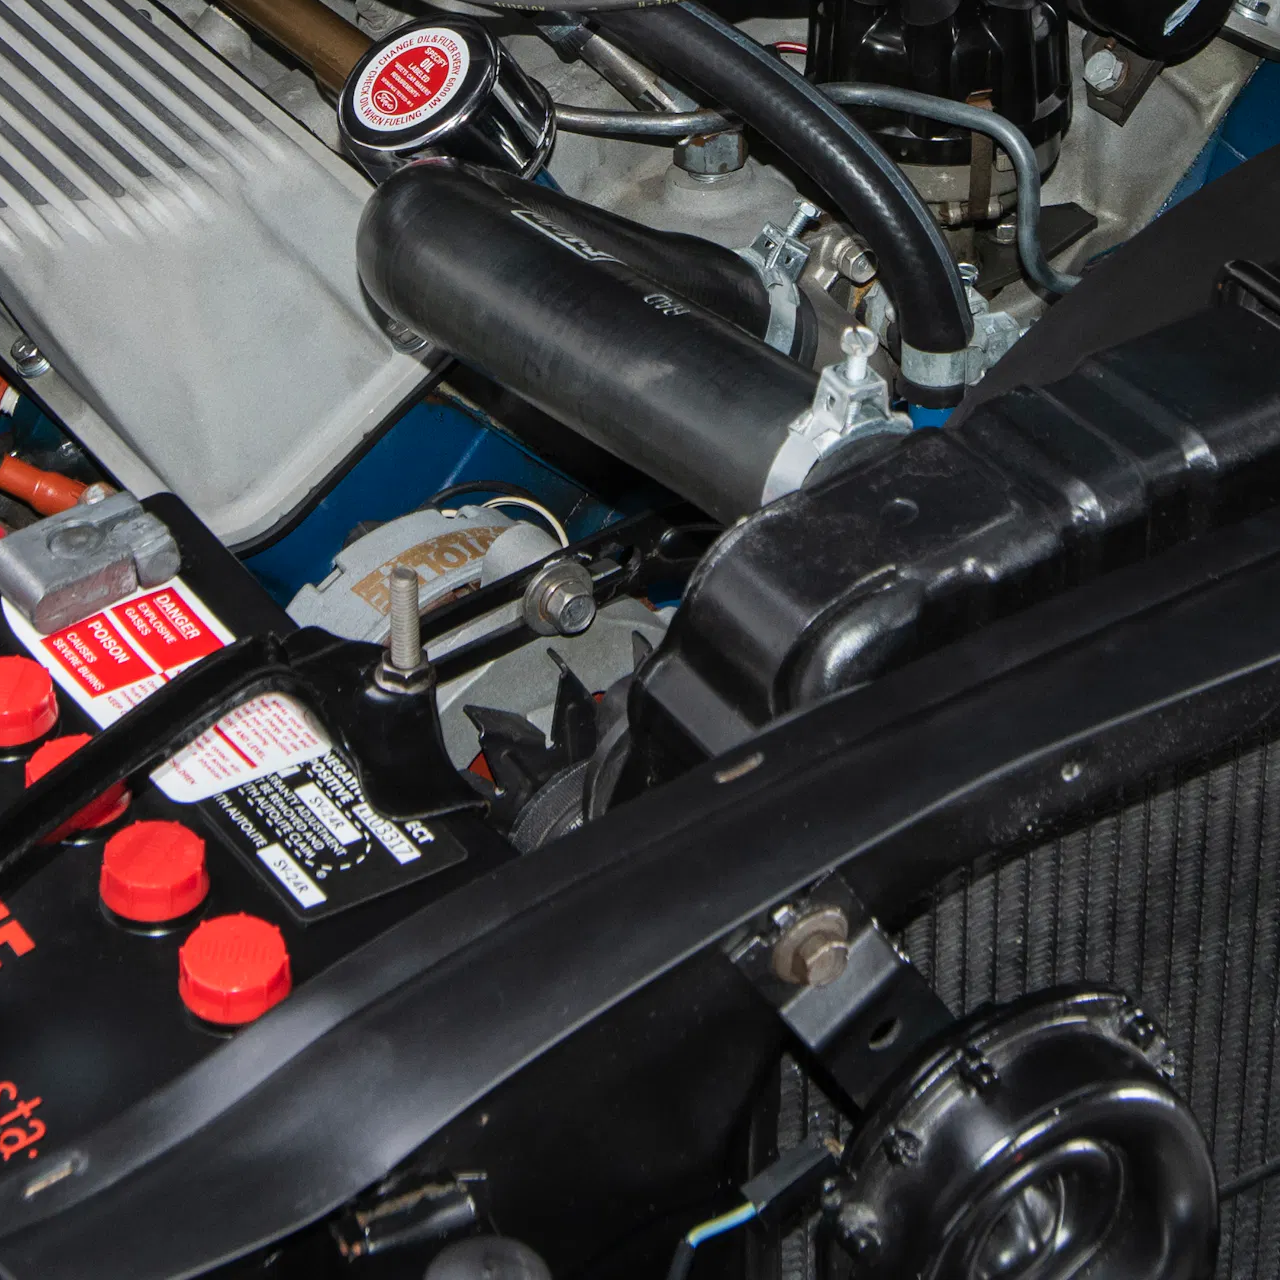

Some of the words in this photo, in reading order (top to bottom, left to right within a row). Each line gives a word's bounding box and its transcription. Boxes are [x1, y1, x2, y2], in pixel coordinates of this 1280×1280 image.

[377, 38, 415, 65] CHANGE
[420, 57, 432, 73] OIL
[424, 46, 448, 68] SPECIFY
[451, 52, 461, 75] EVERY
[359, 69, 377, 98] CHECK
[407, 62, 430, 84] LABELED
[441, 77, 456, 98] 6000
[359, 97, 370, 111] OIL
[428, 95, 442, 109] MI
[362, 108, 384, 126] WHEN
[384, 109, 422, 127] FUELING
[125, 607, 151, 636] GASES
[137, 603, 178, 645] EXPLOSIVE
[155, 595, 201, 640] DANGER
[67, 632, 98, 663] CAUSES
[88, 621, 131, 664] POISON
[53, 638, 82, 669] SEVERE
[77, 664, 106, 692] BURNS
[226, 805, 268, 848] AUTOLITE
[259, 782, 273, 797] BE
[270, 795, 307, 832] REMOVED
[303, 829, 324, 851] AND
[308, 796, 345, 830] SV-24R
[255, 796, 291, 835] AUTOLITE
[289, 830, 317, 860] CLAIM
[294, 805, 346, 856] ADJUSTMENT
[273, 859, 310, 894] SV-24R
